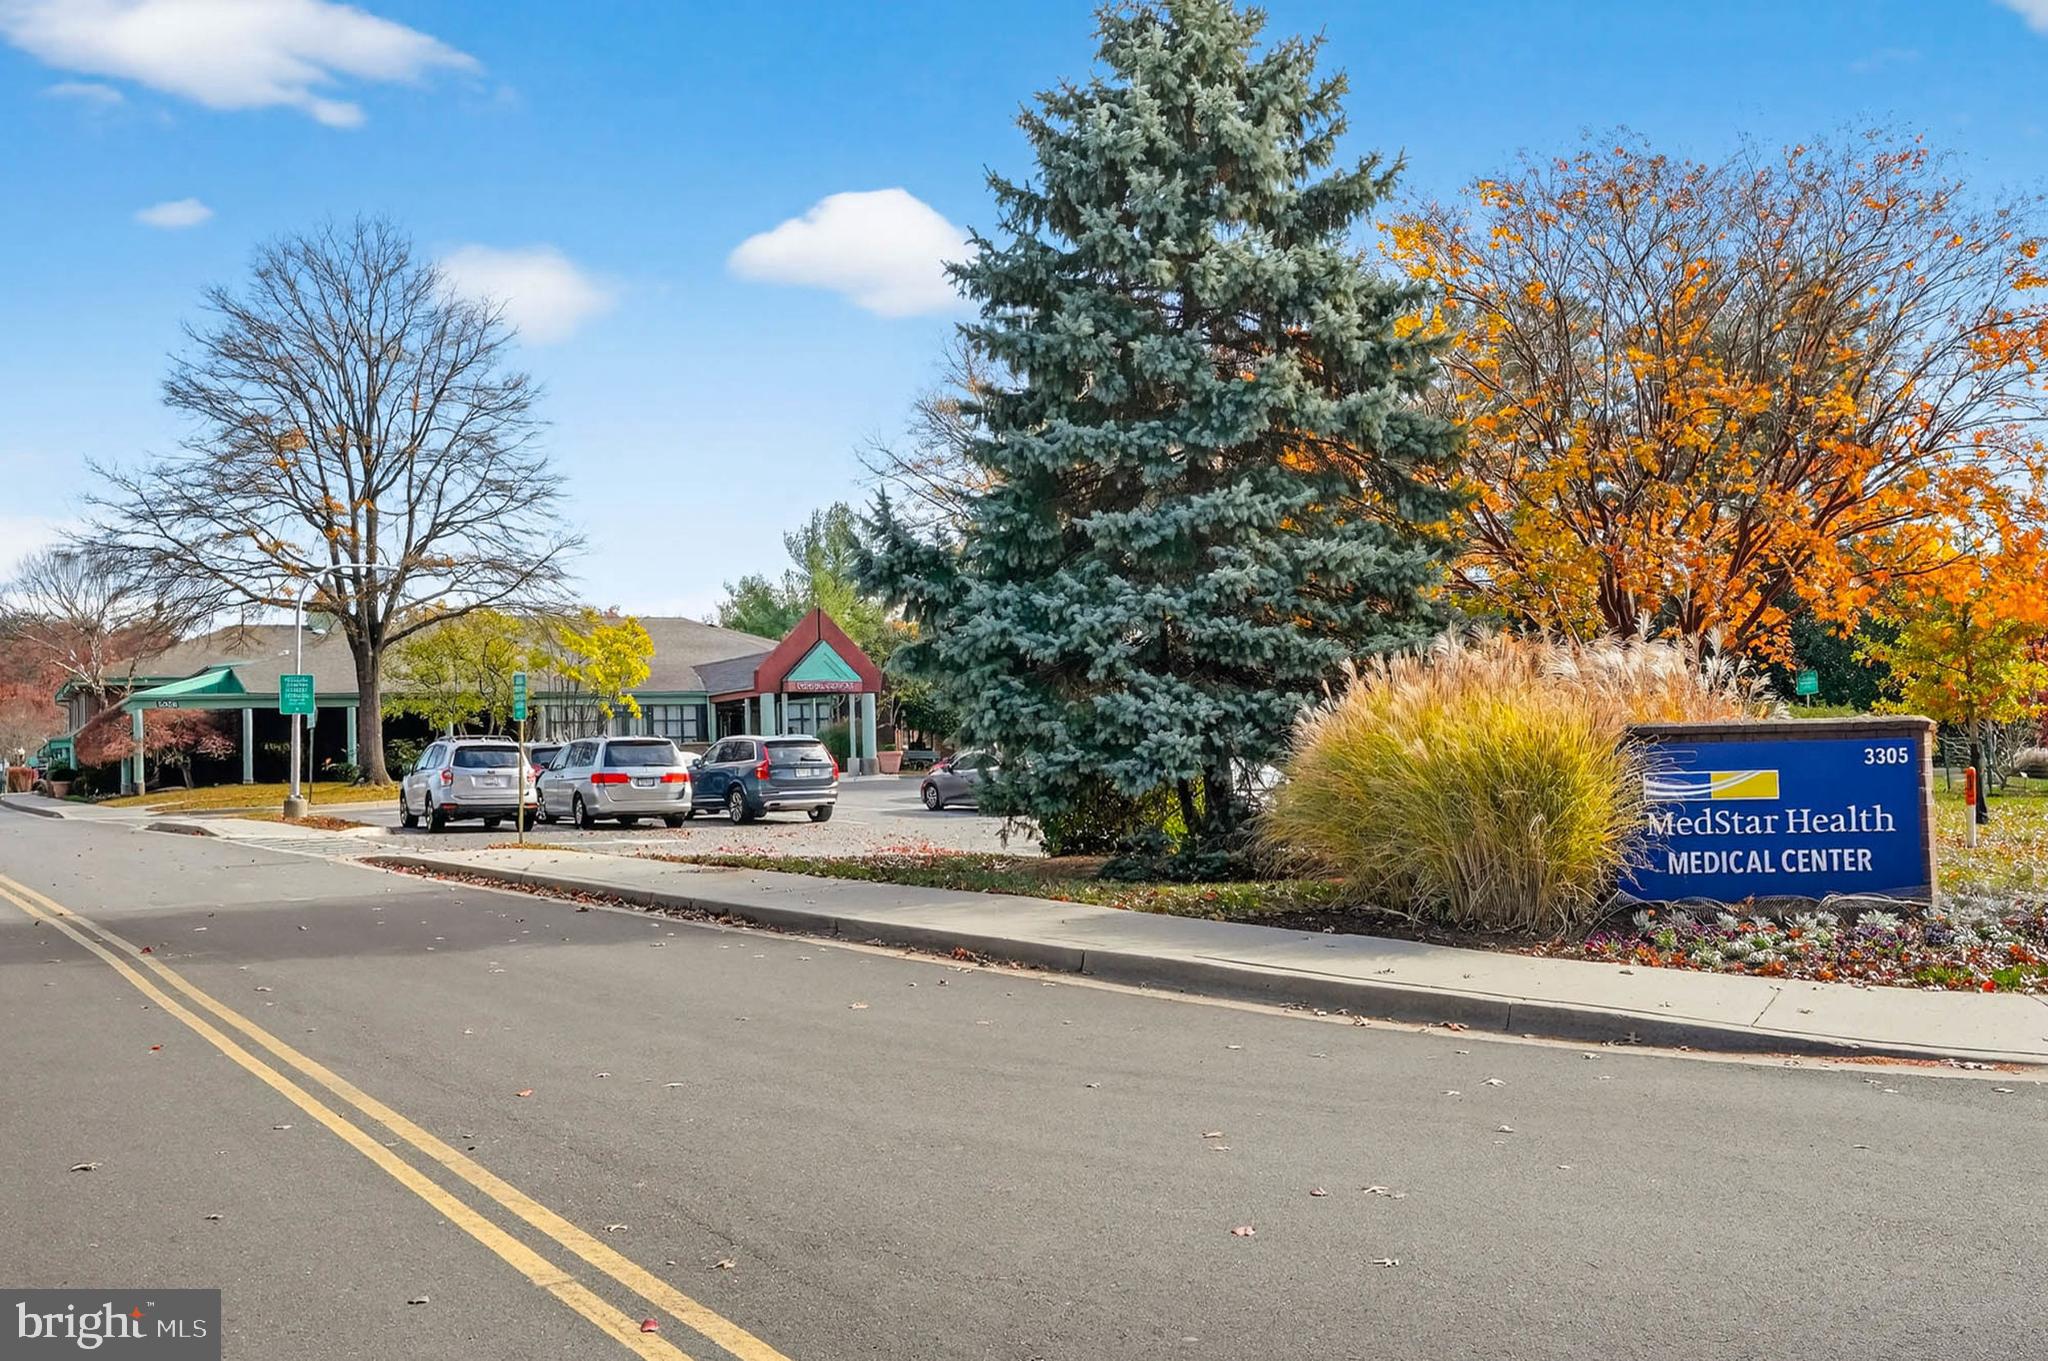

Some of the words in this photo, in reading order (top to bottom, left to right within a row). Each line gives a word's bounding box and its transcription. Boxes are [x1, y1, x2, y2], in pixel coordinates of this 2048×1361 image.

[1864, 747, 1909, 765] 3305
[1647, 808, 1780, 837] MedStar
[1785, 804, 1897, 834] Health
[1667, 850, 1777, 876] MEDICAL
[1781, 848, 1873, 873] CENTER
